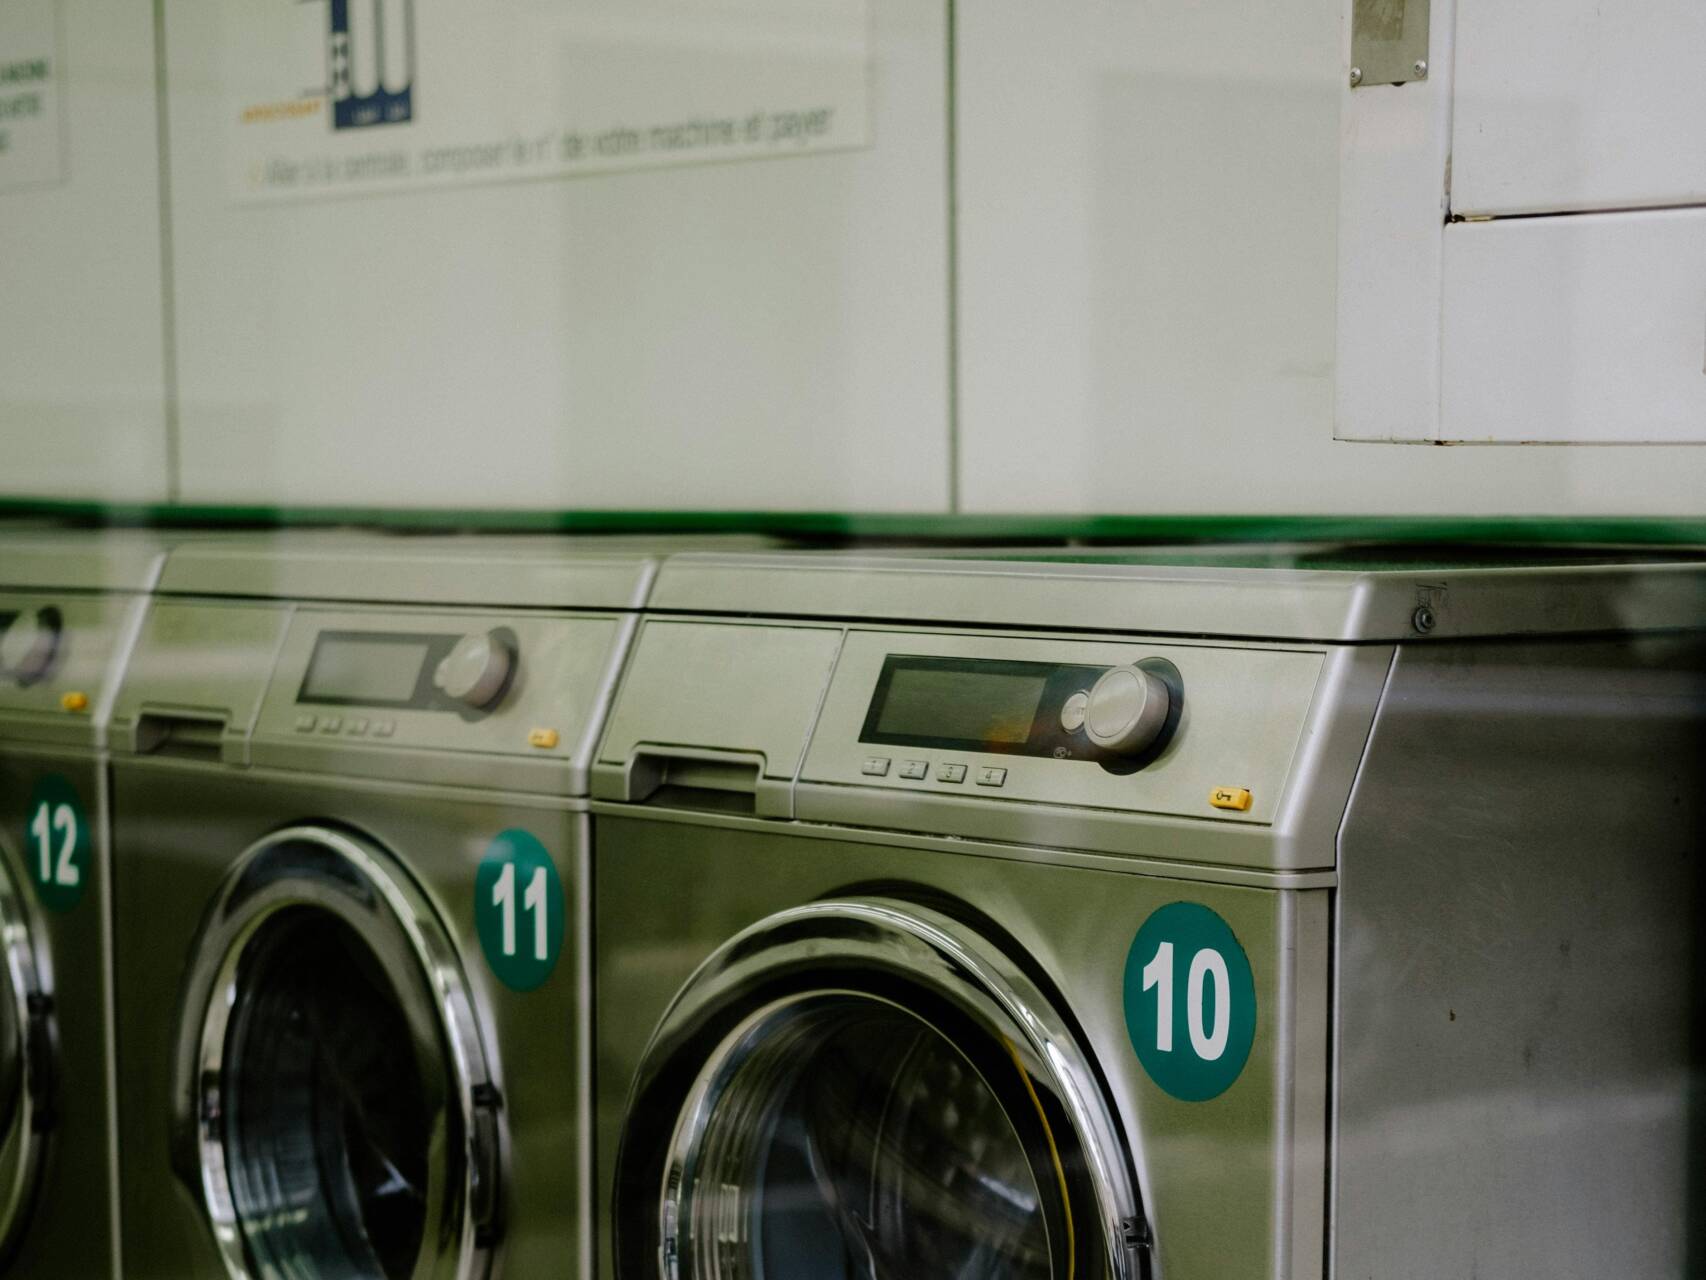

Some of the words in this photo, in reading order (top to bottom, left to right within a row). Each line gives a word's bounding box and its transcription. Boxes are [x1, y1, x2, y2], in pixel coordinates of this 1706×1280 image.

[650, 118, 733, 149] machine
[771, 106, 836, 143] payer
[31, 799, 80, 887] 12
[491, 861, 548, 962] 11
[1142, 941, 1231, 1061] 10
